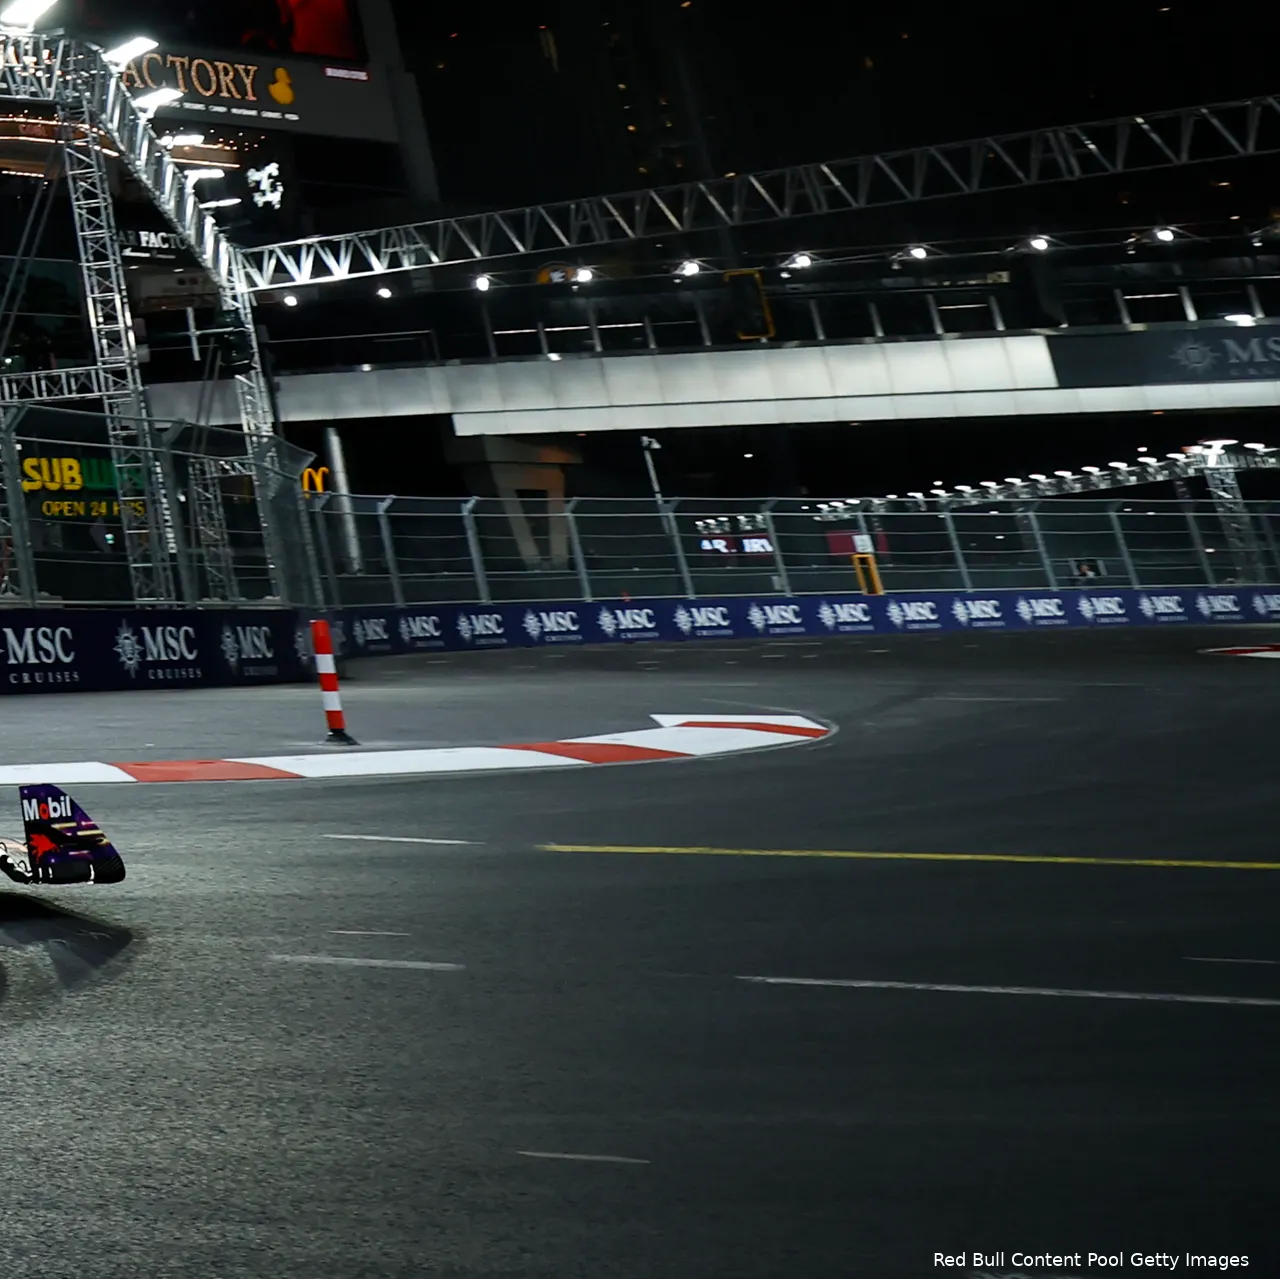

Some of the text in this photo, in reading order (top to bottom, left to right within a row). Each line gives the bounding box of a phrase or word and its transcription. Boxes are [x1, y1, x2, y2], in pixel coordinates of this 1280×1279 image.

[122, 52, 258, 102] ACTORY
[41, 500, 86, 517] OPEN
[90, 500, 108, 517] 24
[614, 609, 657, 629] MSC
[690, 606, 730, 626] MSC
[763, 605, 803, 624] MSC
[832, 603, 872, 622] MSC
[901, 602, 939, 621] MSC
[966, 600, 1002, 618] MSC
[470, 614, 504, 635] MSC
[538, 611, 580, 632] MSC
[3, 627, 76, 665] MSC
[143, 626, 198, 662] MSC
[240, 626, 274, 659] MSC
[9, 672, 81, 684] CRUISES
[23, 796, 72, 821] Mobil
